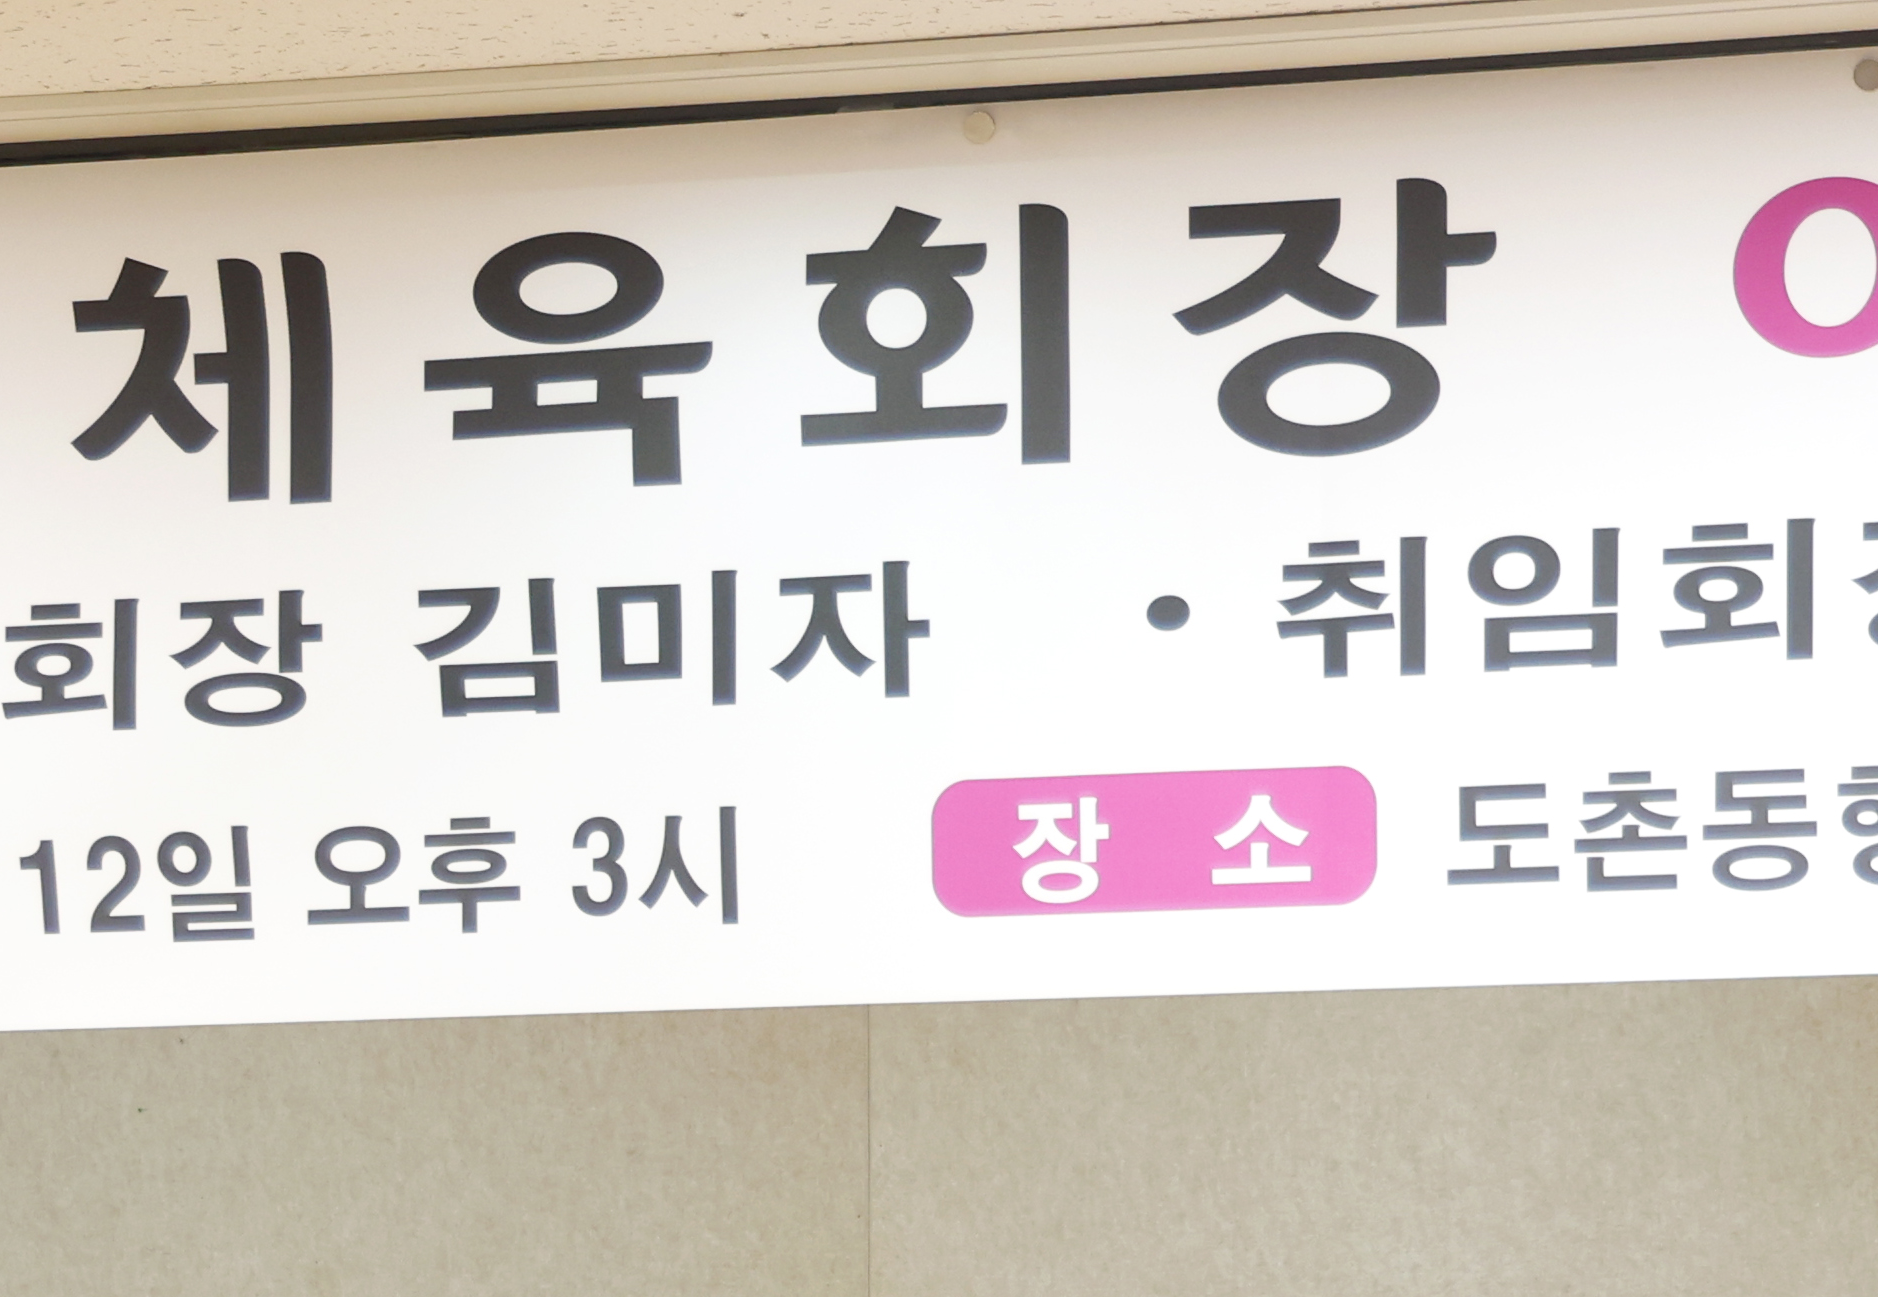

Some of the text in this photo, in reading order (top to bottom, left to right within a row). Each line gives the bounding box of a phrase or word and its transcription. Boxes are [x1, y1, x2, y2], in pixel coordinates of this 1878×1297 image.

[69, 176, 1498, 506] 체육회장
[412, 559, 931, 718] 김미자
[18, 823, 256, 943] 12일
[304, 815, 522, 934] 오후
[570, 804, 740, 925] 3시
